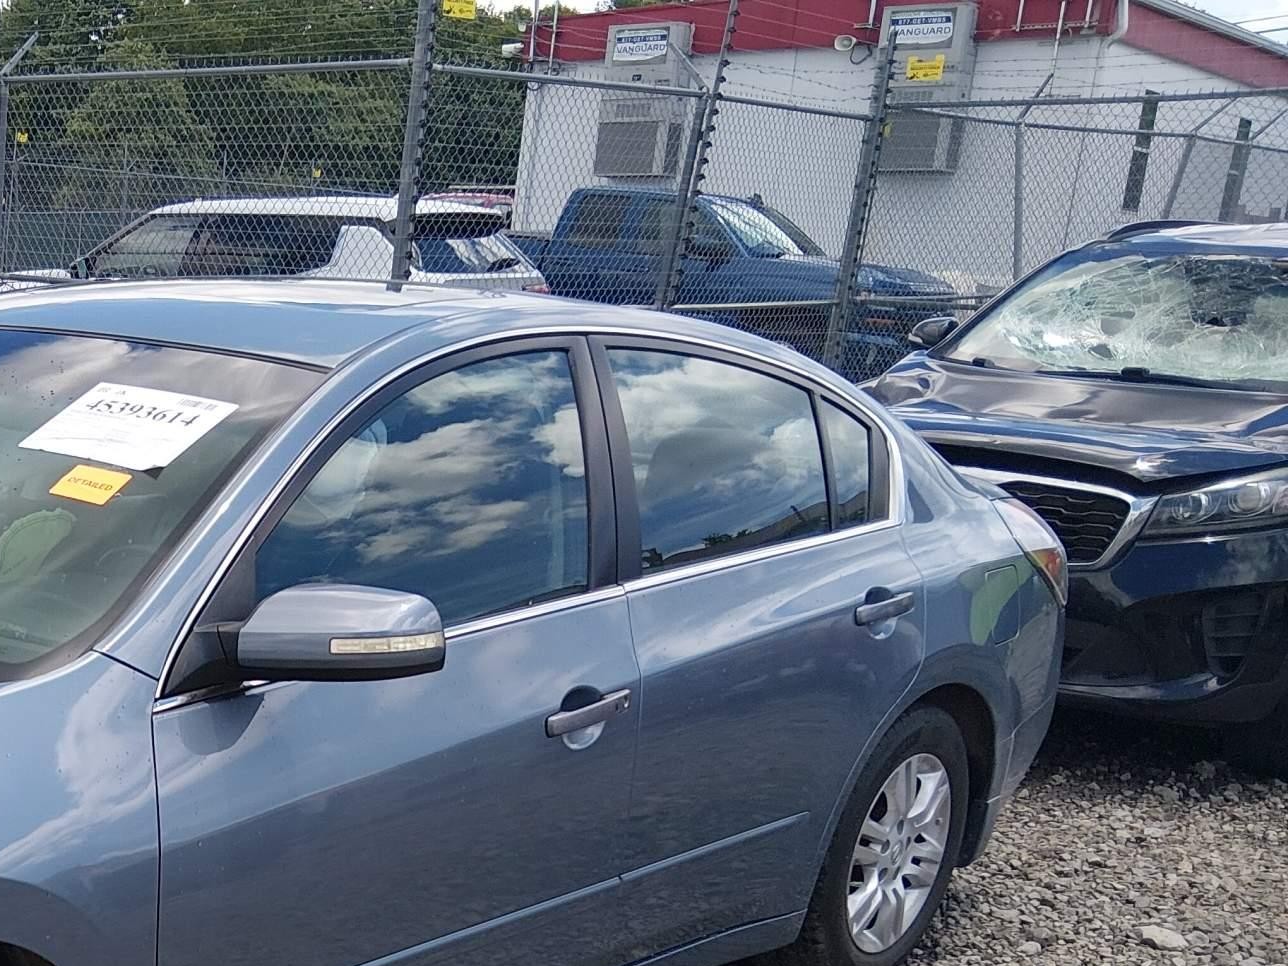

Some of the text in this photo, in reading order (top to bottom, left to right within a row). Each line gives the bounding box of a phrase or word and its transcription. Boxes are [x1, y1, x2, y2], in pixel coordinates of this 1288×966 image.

[616, 44, 665, 53] VANGUARD
[86, 399, 200, 427] 45393614
[67, 477, 113, 491] DETAILED
